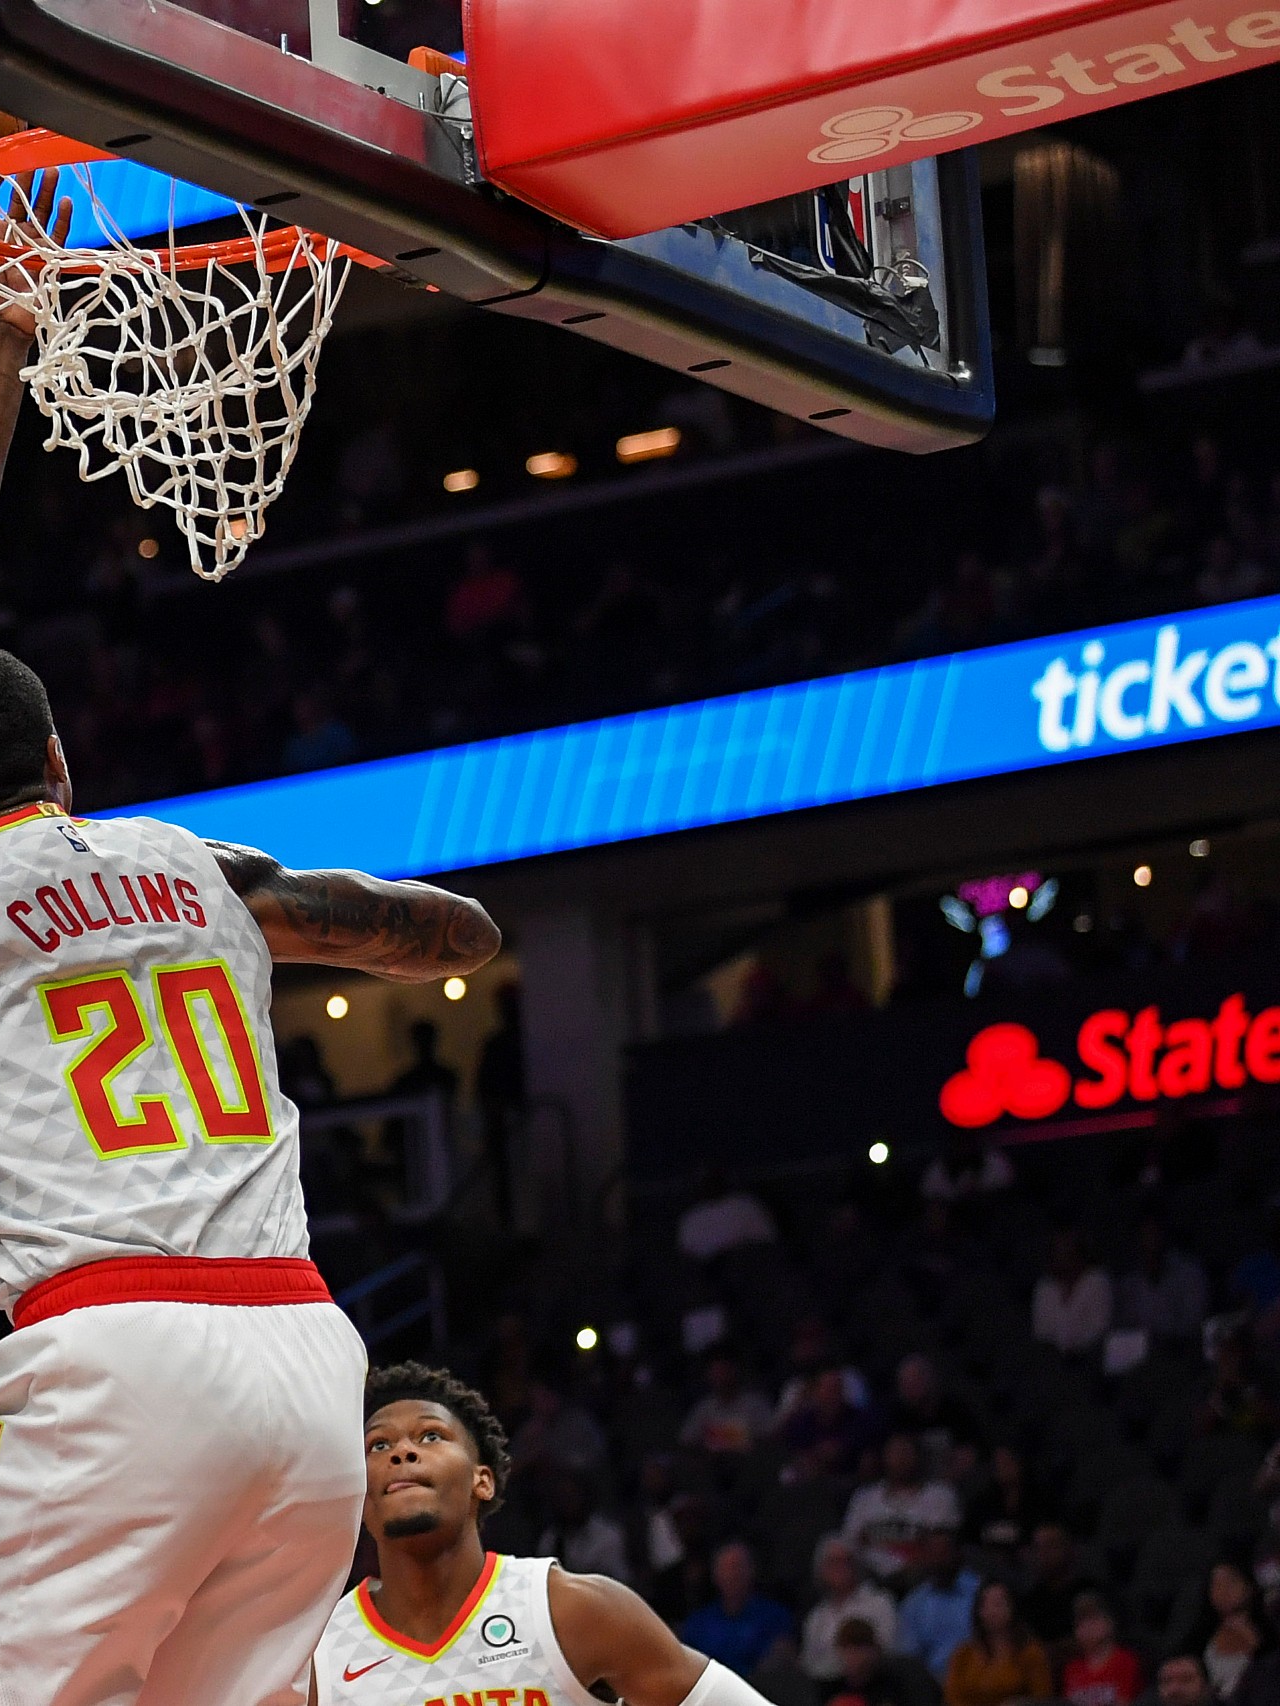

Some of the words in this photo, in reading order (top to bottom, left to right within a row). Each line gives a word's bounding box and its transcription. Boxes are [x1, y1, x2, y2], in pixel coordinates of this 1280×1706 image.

[976, 10, 1280, 117] State
[6, 872, 208, 953] COLLINS
[35, 957, 276, 1161] 20
[1073, 992, 1280, 1109] State
[477, 1647, 529, 1665] sharecare
